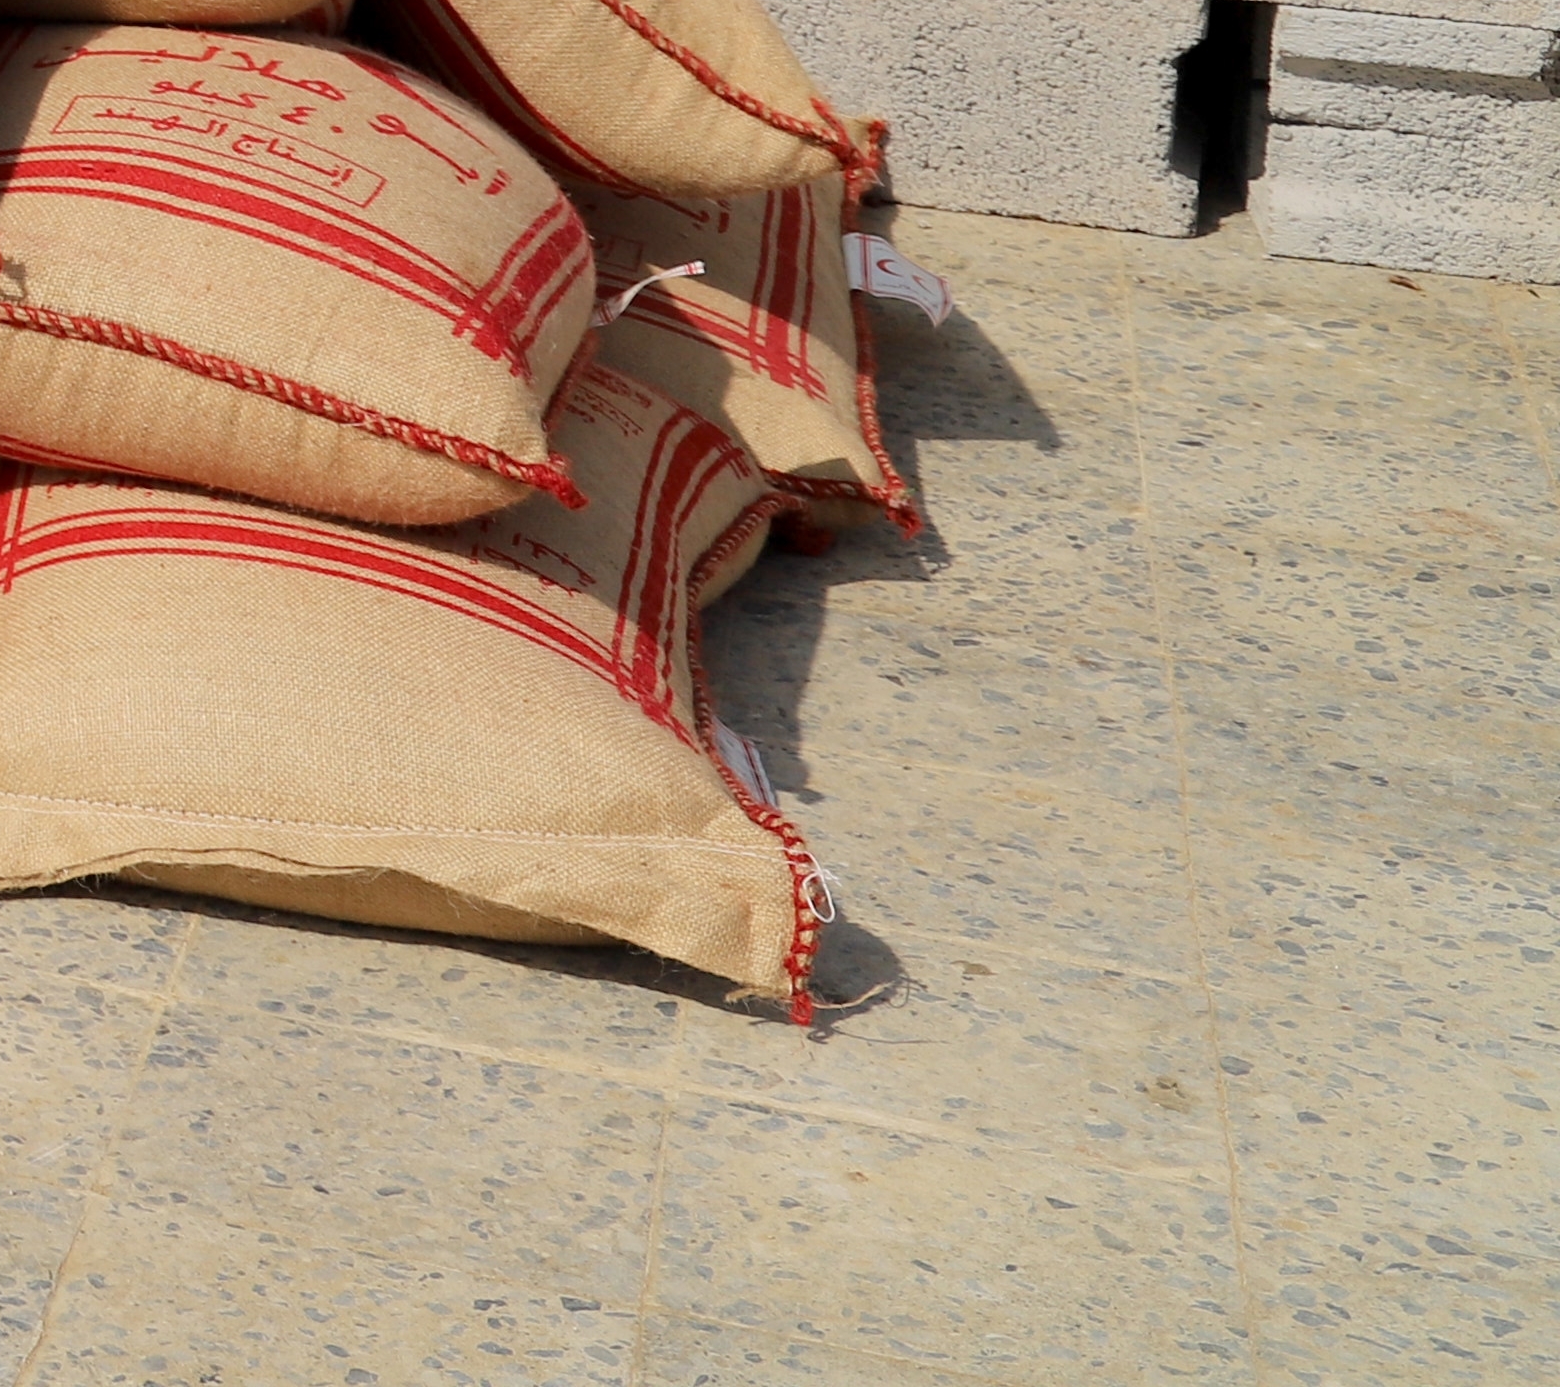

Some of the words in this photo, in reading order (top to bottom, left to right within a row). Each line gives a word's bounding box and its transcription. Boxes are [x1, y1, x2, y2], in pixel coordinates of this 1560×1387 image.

[33, 42, 353, 103] هلالين
[150, 80, 268, 109] كيلو
[95, 108, 229, 137] الهند
[280, 106, 344, 134] ٤٠
[231, 133, 354, 187] إنتاج
